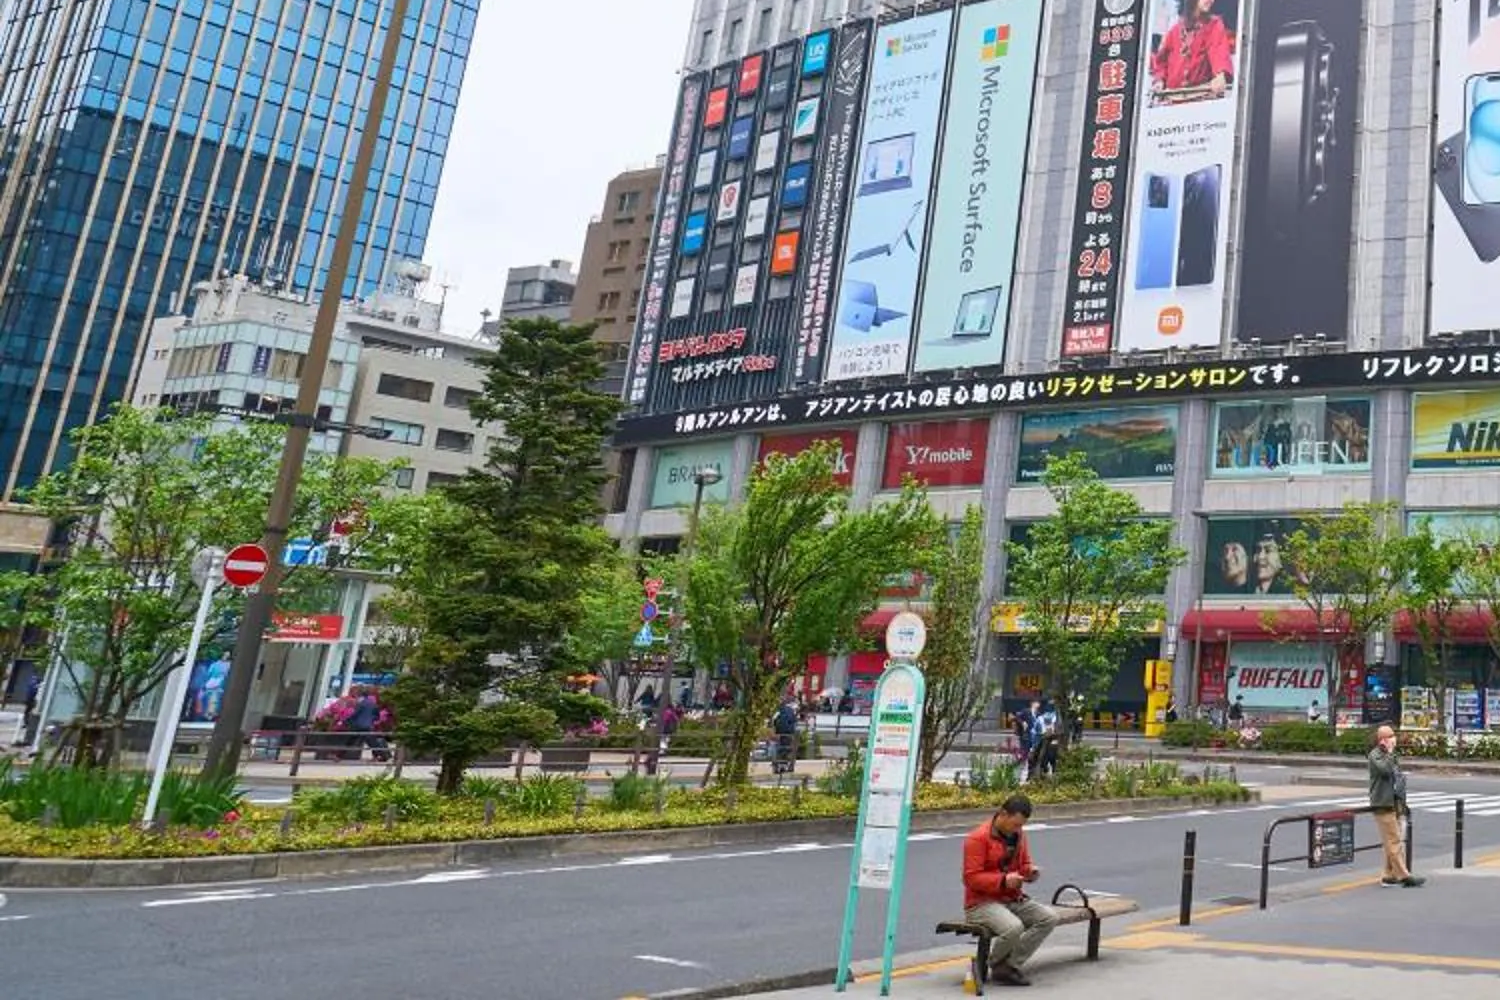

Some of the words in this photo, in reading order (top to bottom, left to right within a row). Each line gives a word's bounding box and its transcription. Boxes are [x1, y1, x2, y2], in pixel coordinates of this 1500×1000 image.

[972, 65, 1001, 177] Microsoft
[1092, 59, 1127, 159] 駐車場
[1090, 180, 1114, 210] 8
[959, 181, 987, 274] Surface
[1077, 248, 1113, 278] 24
[672, 356, 745, 384] マルチメディア
[905, 445, 973, 465] Y!mobile
[1237, 667, 1325, 689] BUFFALO
